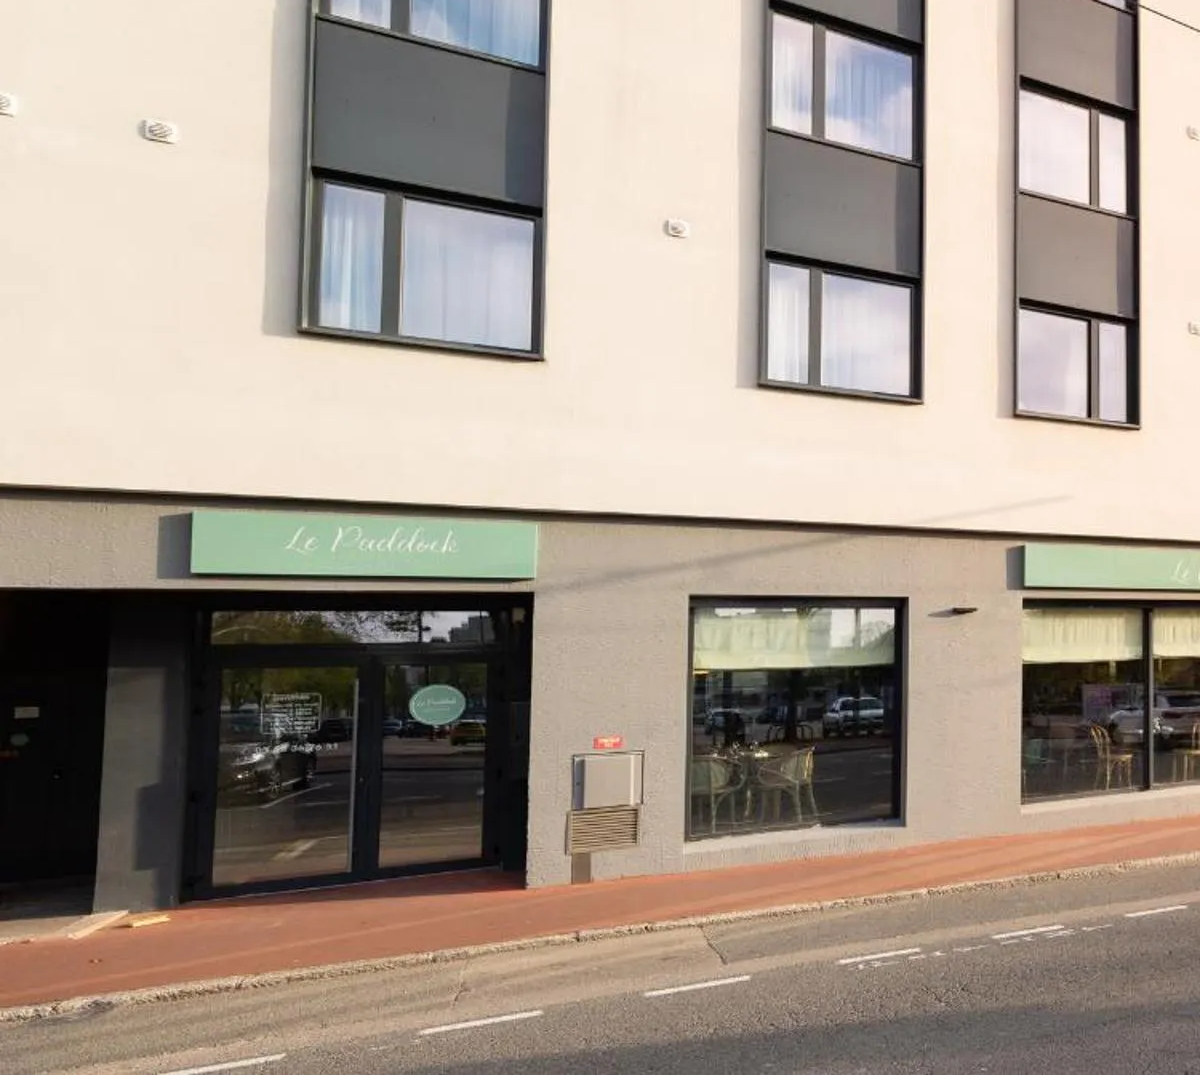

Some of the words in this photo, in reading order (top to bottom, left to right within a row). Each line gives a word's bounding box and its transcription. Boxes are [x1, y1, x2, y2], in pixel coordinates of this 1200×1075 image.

[284, 525, 320, 555] Le
[331, 524, 460, 553] Paddock
[1170, 559, 1191, 585] Le
